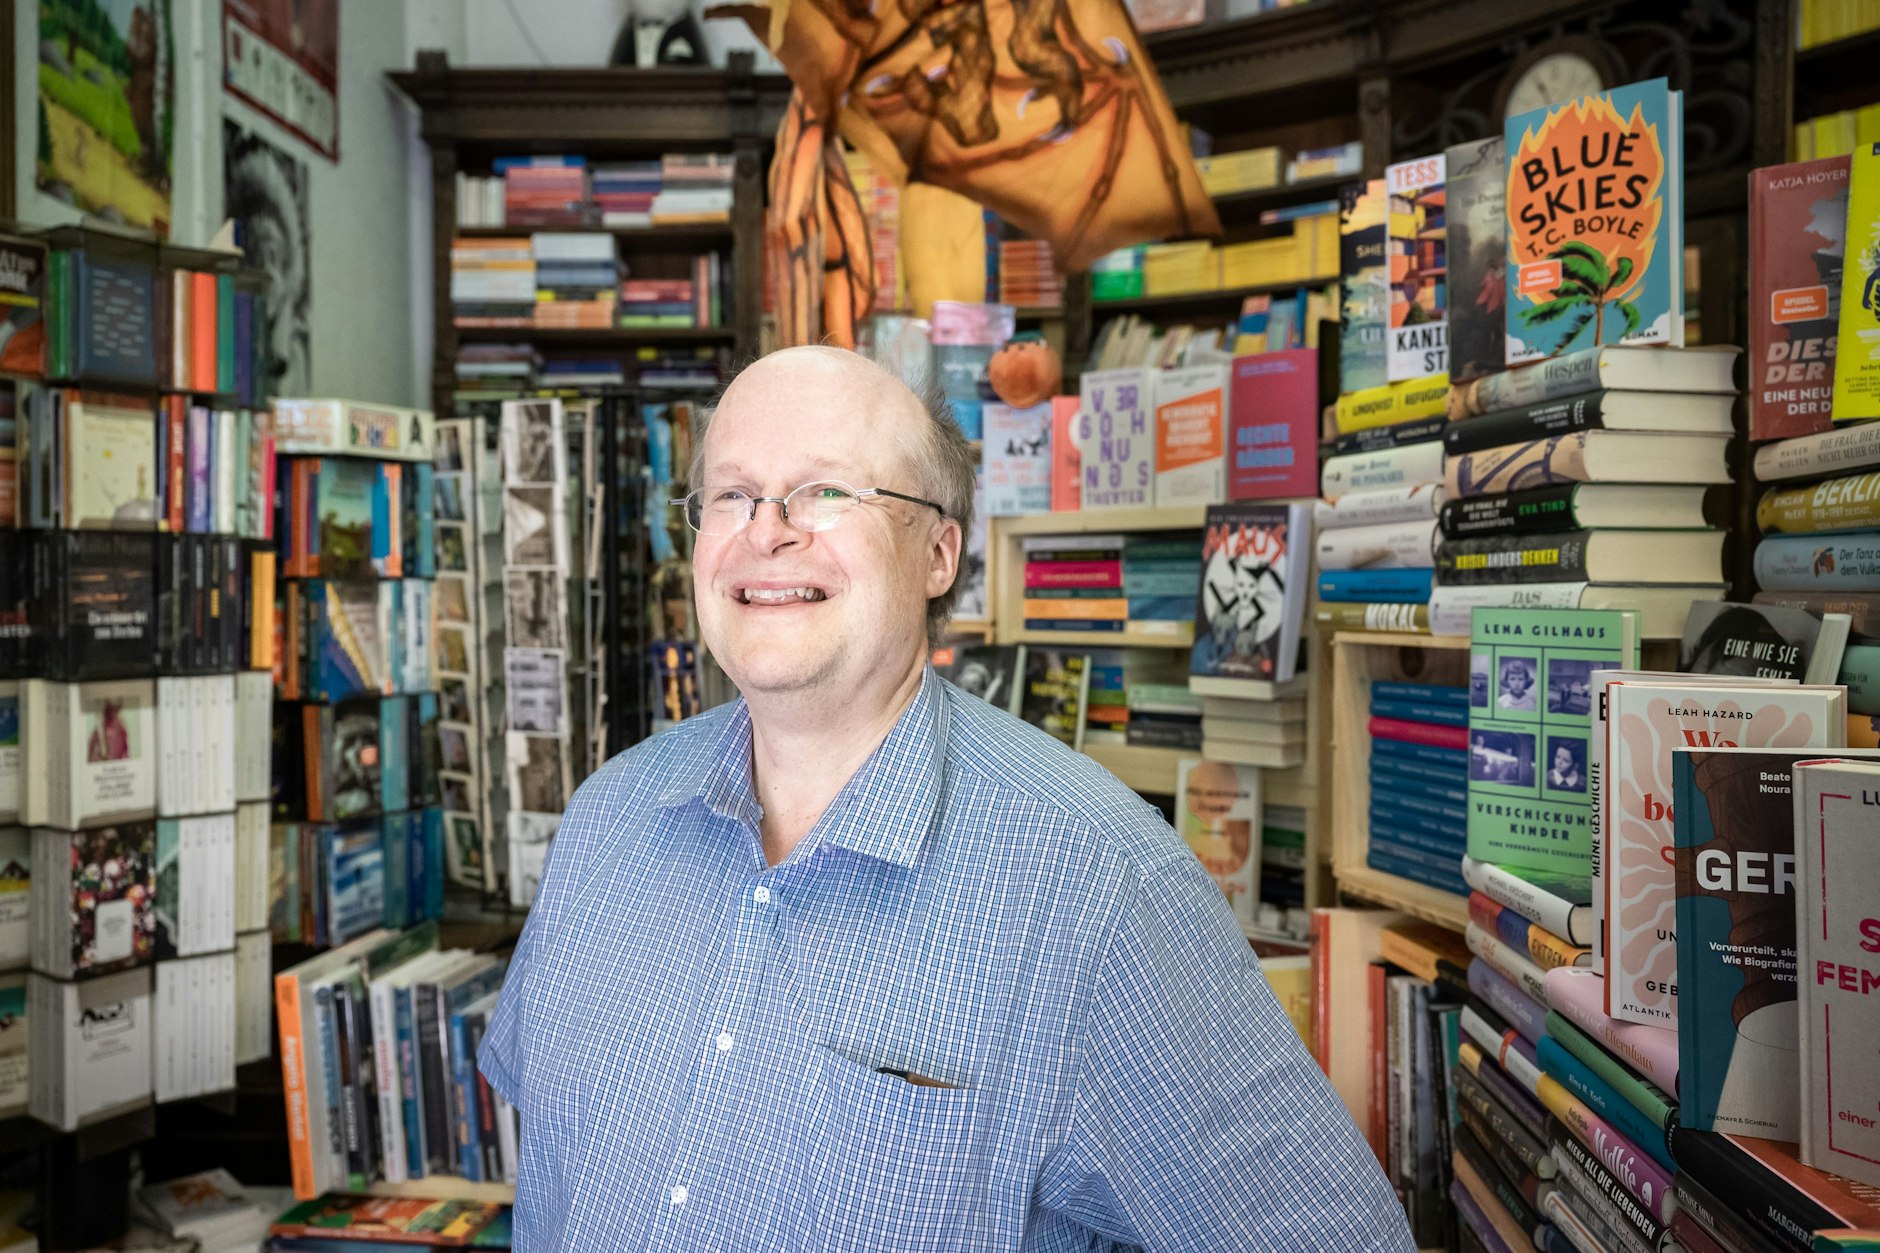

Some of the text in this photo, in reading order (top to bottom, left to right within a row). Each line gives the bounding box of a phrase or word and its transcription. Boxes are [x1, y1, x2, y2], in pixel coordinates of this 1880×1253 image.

[1522, 132, 1640, 192] BLUE
[1394, 159, 1439, 188] TESS
[1769, 169, 1847, 191] KATJA HOYER
[1520, 173, 1649, 235] SKIES
[1526, 215, 1645, 257] T. C. BOYLE
[1765, 361, 1827, 386] DER
[1763, 389, 1797, 404] EINE
[1788, 402, 1818, 416] DER
[1817, 450, 1842, 465] NICHT
[1842, 445, 1868, 461] MEHR
[1518, 500, 1567, 516] EVA TIND
[1202, 522, 1288, 566] MAUS
[1840, 548, 1855, 561] Der
[1856, 547, 1875, 560] Tanz
[1840, 563, 1859, 576] dem
[1365, 603, 1420, 632] MORAL
[1484, 623, 1606, 639] LENA GILHAUS
[1724, 638, 1800, 665] EINE WIE SIE
[1668, 707, 1753, 720] LEAH HAZARD
[1760, 771, 1791, 782] Beate
[1759, 784, 1791, 794] Noura
[1476, 802, 1593, 827] VERSCHICKUN
[1591, 762, 1601, 878] MEINE GESCHICHTE
[1510, 823, 1571, 841] KINDER
[1488, 840, 1503, 849] EINE
[1709, 941, 1778, 957] Vorverurteilt,
[1722, 955, 1742, 966] Wie
[1622, 1003, 1671, 1019] ATLANTIK
[1605, 1026, 1654, 1073] Elternhaus
[1707, 1113, 1778, 1129] KREMAYR & SCHERIAU
[1838, 1110, 1877, 1130] einer
[1593, 1127, 1643, 1202] Midlife
[1566, 1138, 1585, 1163] MIEKO
[1584, 1156, 1600, 1180] ALL
[1597, 1169, 1612, 1192] DIE
[1611, 1184, 1656, 1240] LIEBENDEN
[1678, 1187, 1715, 1228] DENISE MINA
